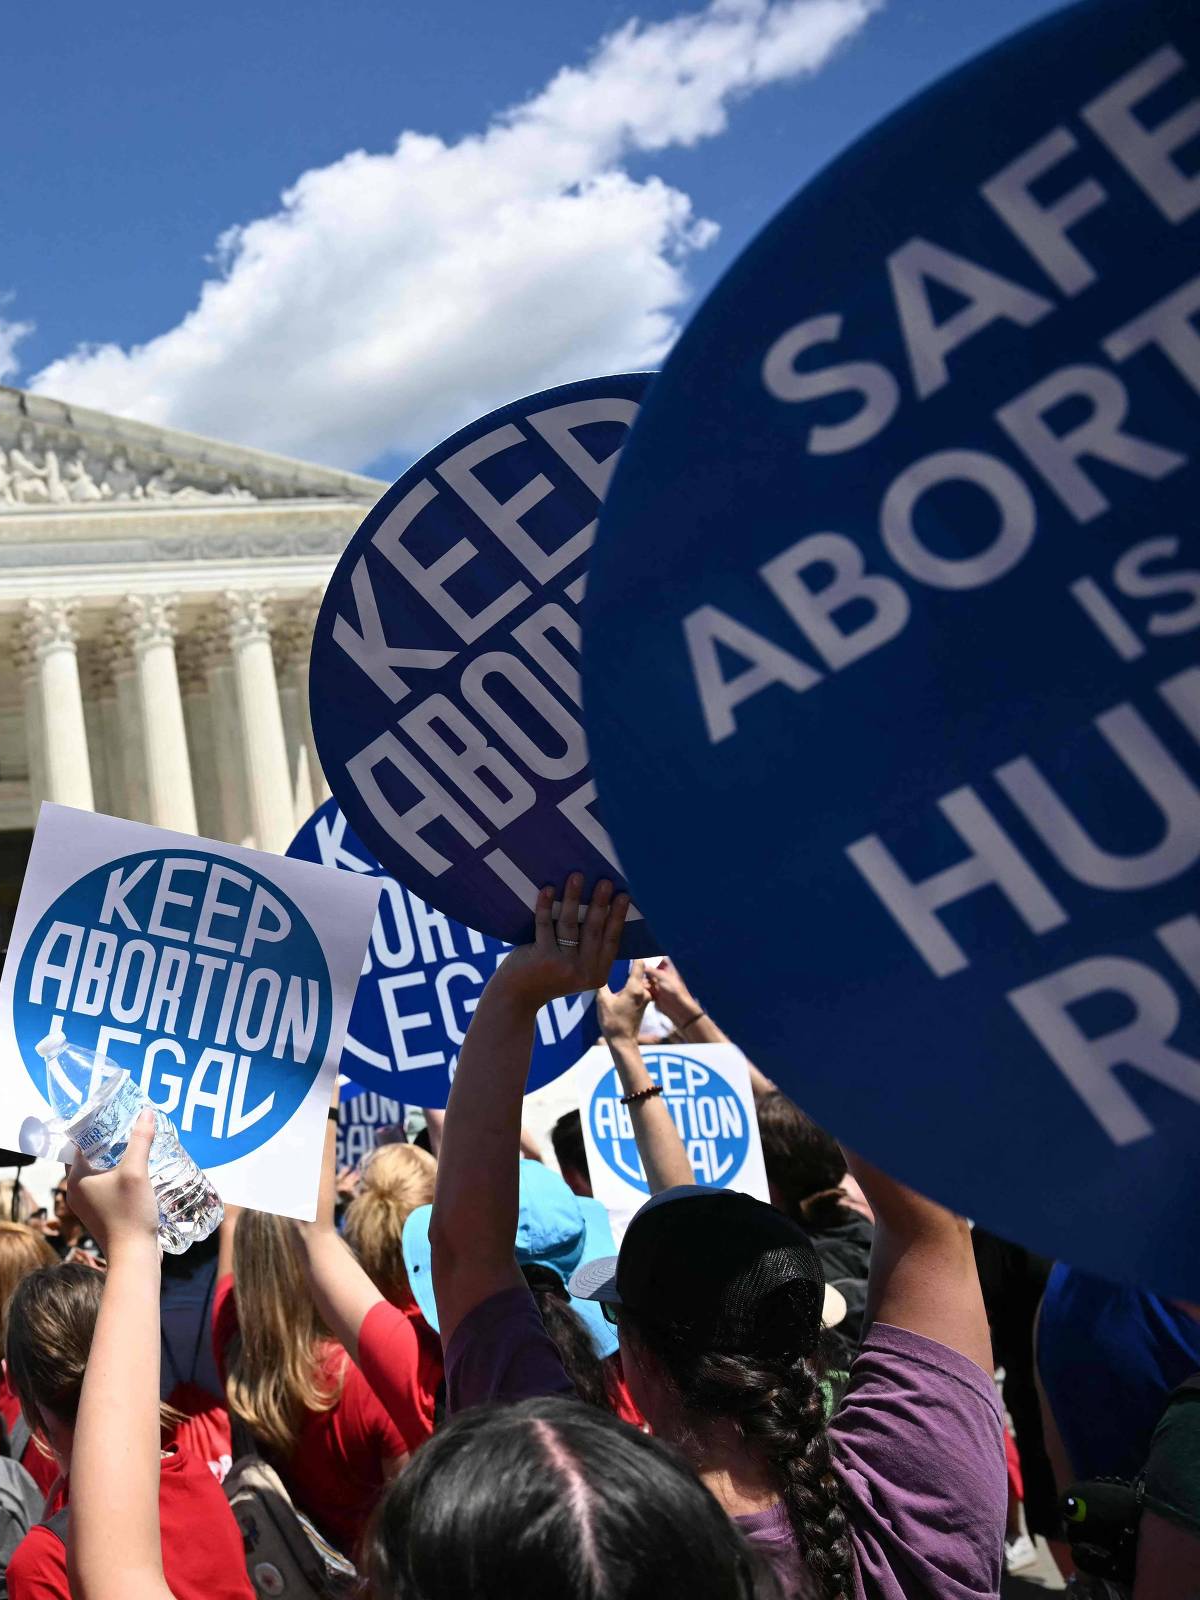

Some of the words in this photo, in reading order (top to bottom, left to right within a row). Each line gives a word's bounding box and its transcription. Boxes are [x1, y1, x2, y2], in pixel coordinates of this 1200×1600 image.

[763, 43, 1200, 455] SAFE
[1069, 536, 1200, 659] IS
[99, 857, 292, 957] KEEP
[29, 920, 319, 1064] ABORTION
[594, 1096, 743, 1140] ABTION
[612, 1139, 734, 1184] LAL
